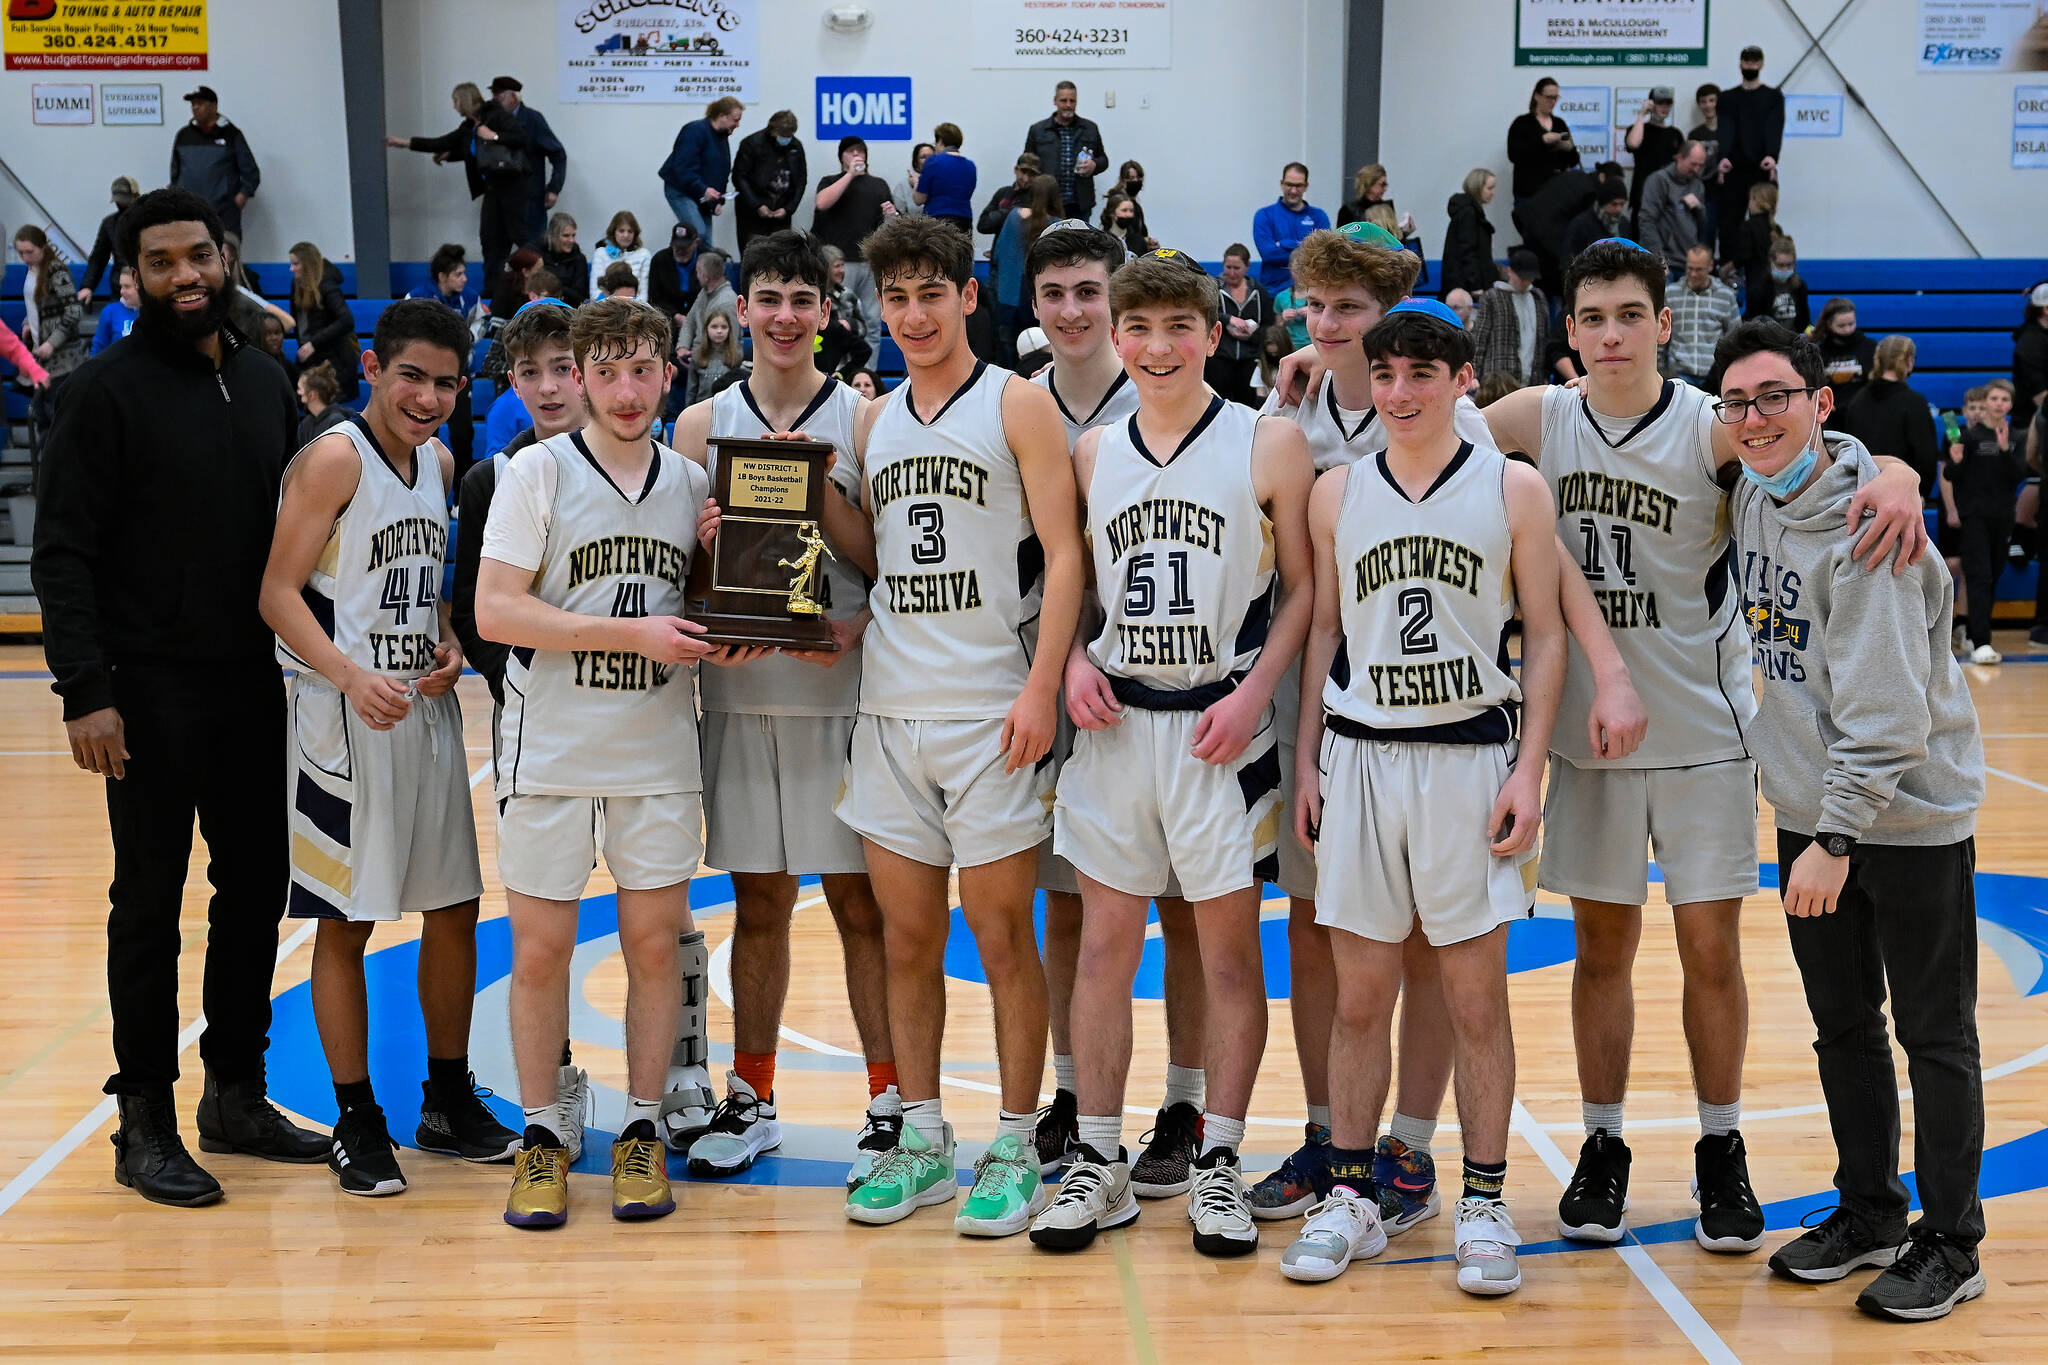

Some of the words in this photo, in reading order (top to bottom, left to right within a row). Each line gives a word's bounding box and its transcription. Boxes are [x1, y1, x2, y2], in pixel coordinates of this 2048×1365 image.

[62, 5, 108, 17] TOWING
[112, 5, 120, 17] &
[125, 5, 155, 17] AUTO
[159, 5, 202, 17] REPAIR
[64, 23, 90, 35] Repair
[171, 24, 199, 35] Towing
[1548, 18, 1575, 27] BERG
[1578, 18, 1585, 27] &
[1548, 29, 1589, 38] WEALTH
[1592, 29, 1668, 38] MANAGEMENT
[43, 35, 168, 48] 360.424.4517
[1015, 47, 1126, 57] www.bladechevy.com
[1923, 43, 2002, 64] Express
[13, 54, 200, 66] www.budgettowingandrepair.com
[36, 97, 90, 110] LUMMI
[821, 93, 906, 125] HOME
[1560, 102, 1600, 112] GRACE
[108, 107, 156, 115] LUTHERAN
[1797, 109, 1830, 121] MVC
[743, 462, 756, 470] NW
[758, 463, 792, 472] DISTRICT
[749, 474, 765, 482] Boys
[767, 475, 803, 483] Basketball
[750, 484, 789, 493] Champions
[871, 455, 990, 517] NORTHWEST
[754, 495, 784, 504] 2021-22
[907, 502, 947, 565] 3
[1105, 498, 1226, 565] NORTHWEST
[367, 517, 446, 573] NORTHWES
[1580, 518, 1636, 586] 11
[1355, 535, 1484, 605] NORTHWEST
[1124, 551, 1195, 617] 51
[379, 565, 436, 625] 44
[884, 568, 982, 614] YESHIVA
[1397, 587, 1439, 655] 2
[1116, 623, 1216, 665] YESHIVA
[1368, 655, 1483, 706] YESHIVA
